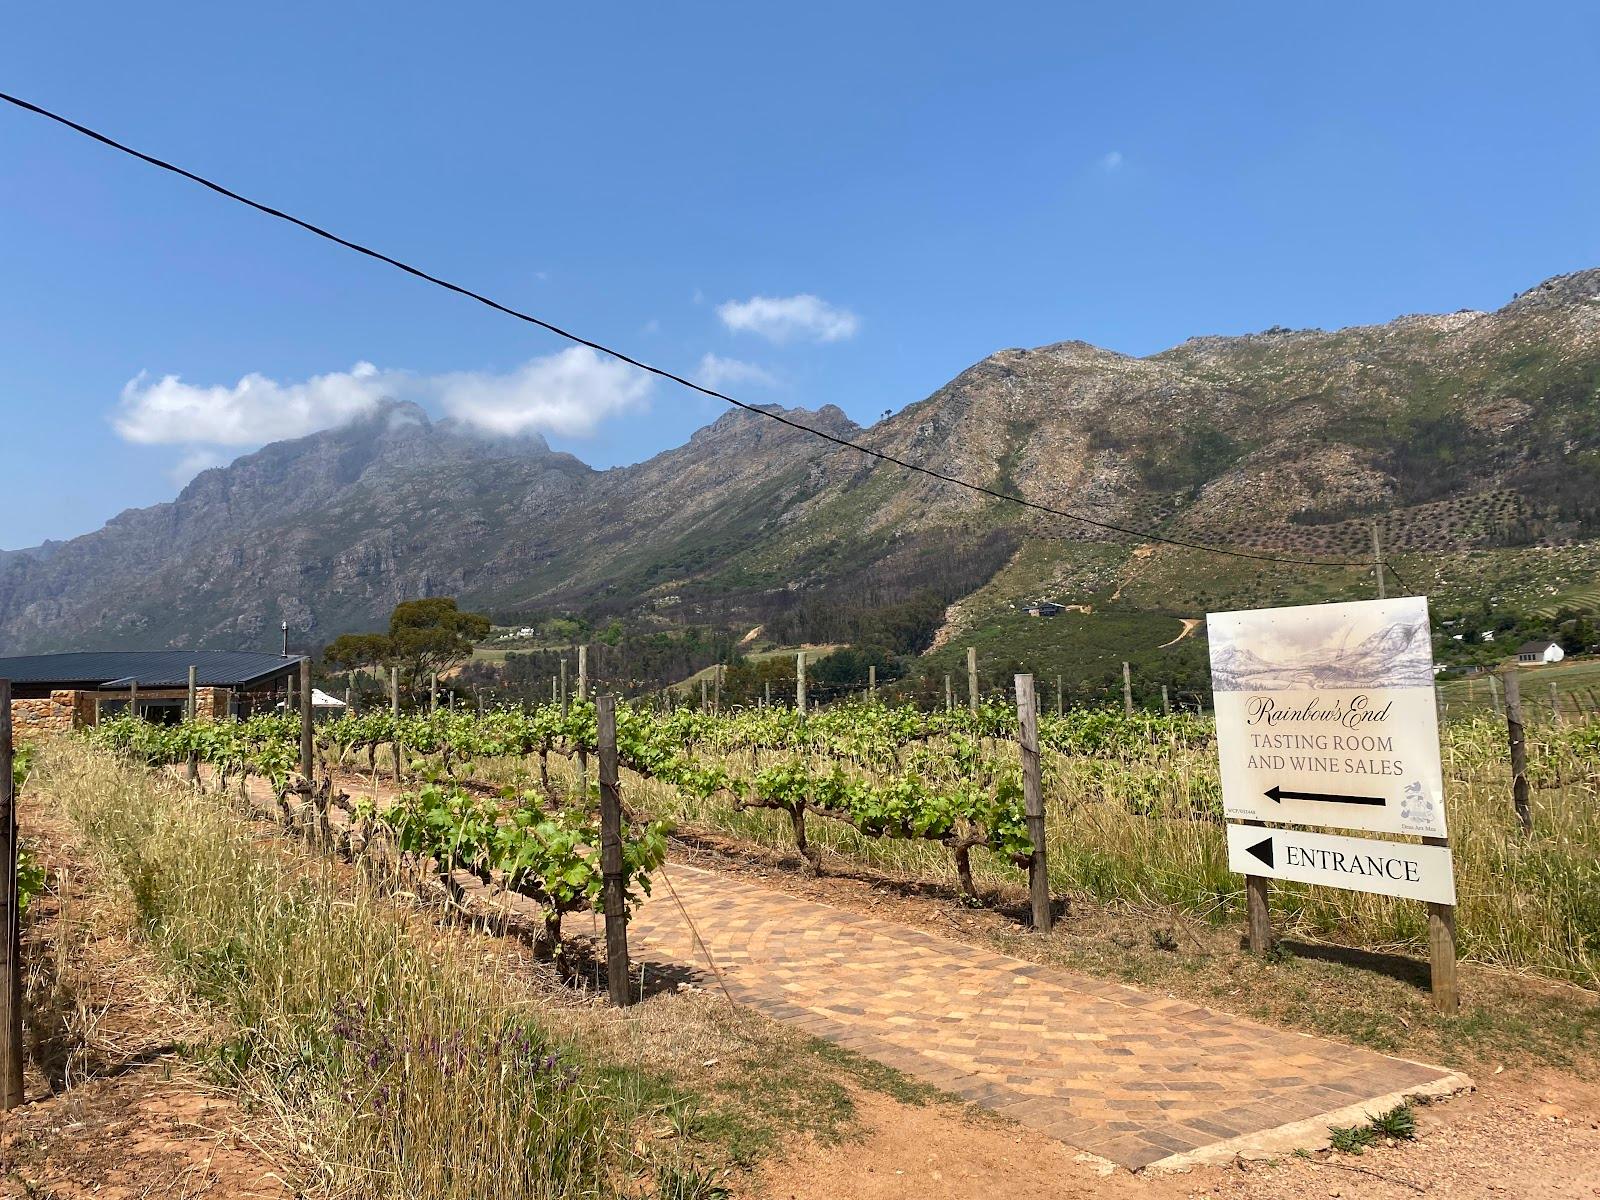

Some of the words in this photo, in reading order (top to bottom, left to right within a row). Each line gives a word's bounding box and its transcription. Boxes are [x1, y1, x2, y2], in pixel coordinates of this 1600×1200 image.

[1245, 696, 1341, 726] Rainbow's
[1341, 694, 1393, 730] End
[1250, 734, 1328, 750] TASTING
[1333, 736, 1393, 752] ROOM
[1247, 755, 1285, 770] AND
[1290, 757, 1340, 773] WINE
[1344, 759, 1404, 776] SALES
[1285, 845, 1421, 883] ENTRANCE
